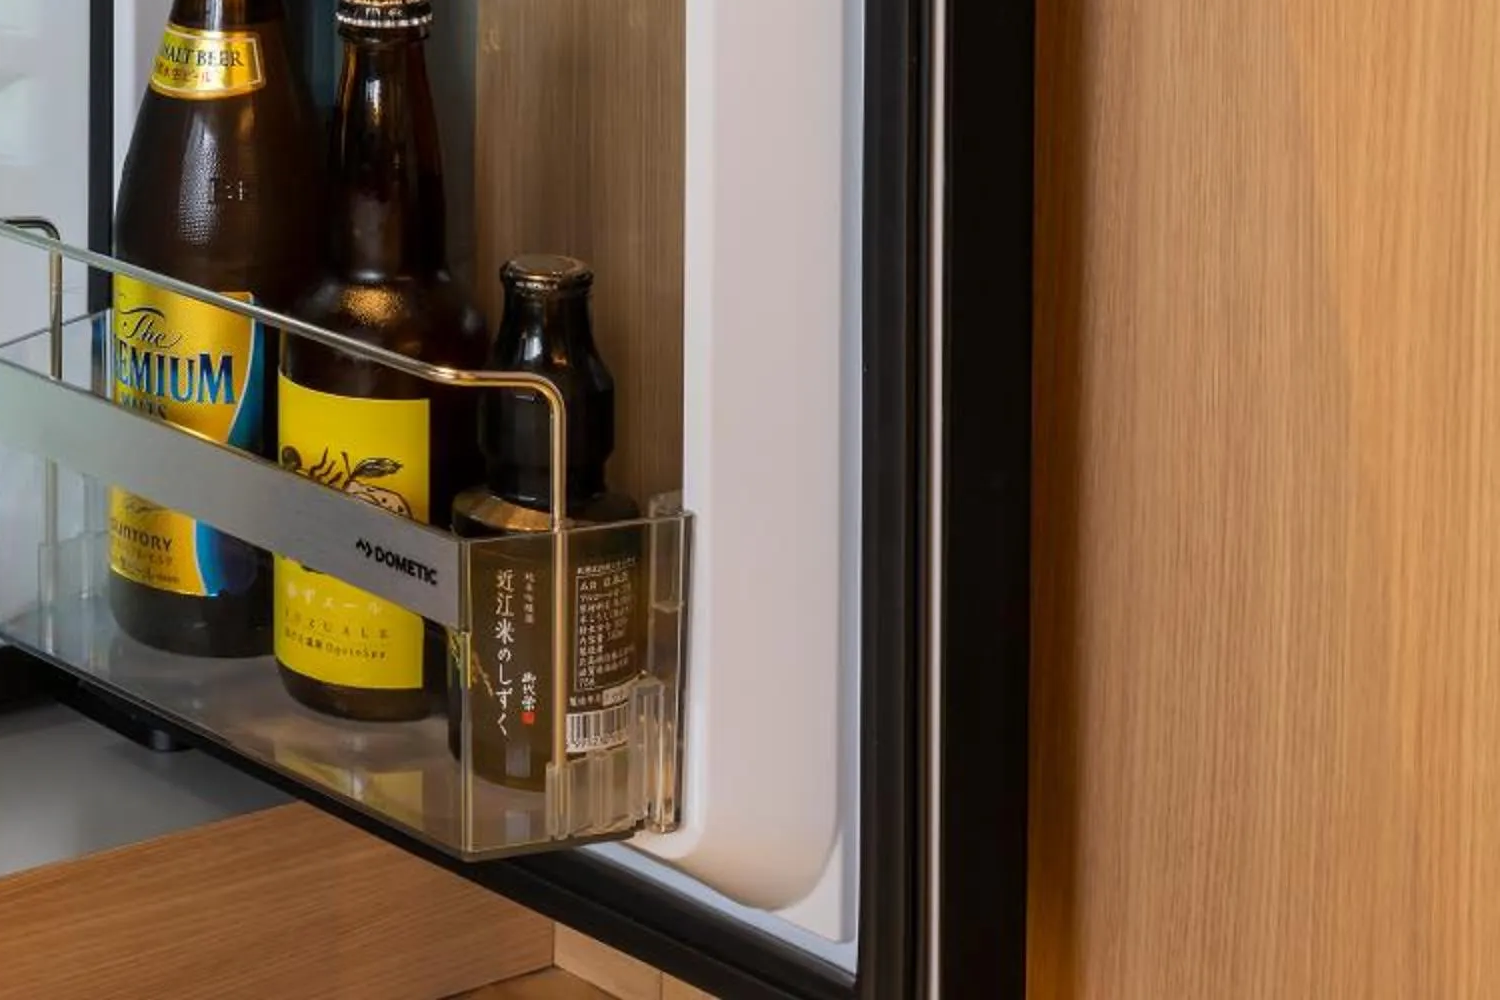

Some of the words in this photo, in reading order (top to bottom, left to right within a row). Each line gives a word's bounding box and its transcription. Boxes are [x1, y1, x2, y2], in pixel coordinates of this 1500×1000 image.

[196, 49, 244, 67] BEER
[119, 307, 182, 349] The
[117, 338, 236, 405] EMIUM
[374, 545, 438, 586] DOMETIC
[494, 568, 515, 736] 近江米のしずく
